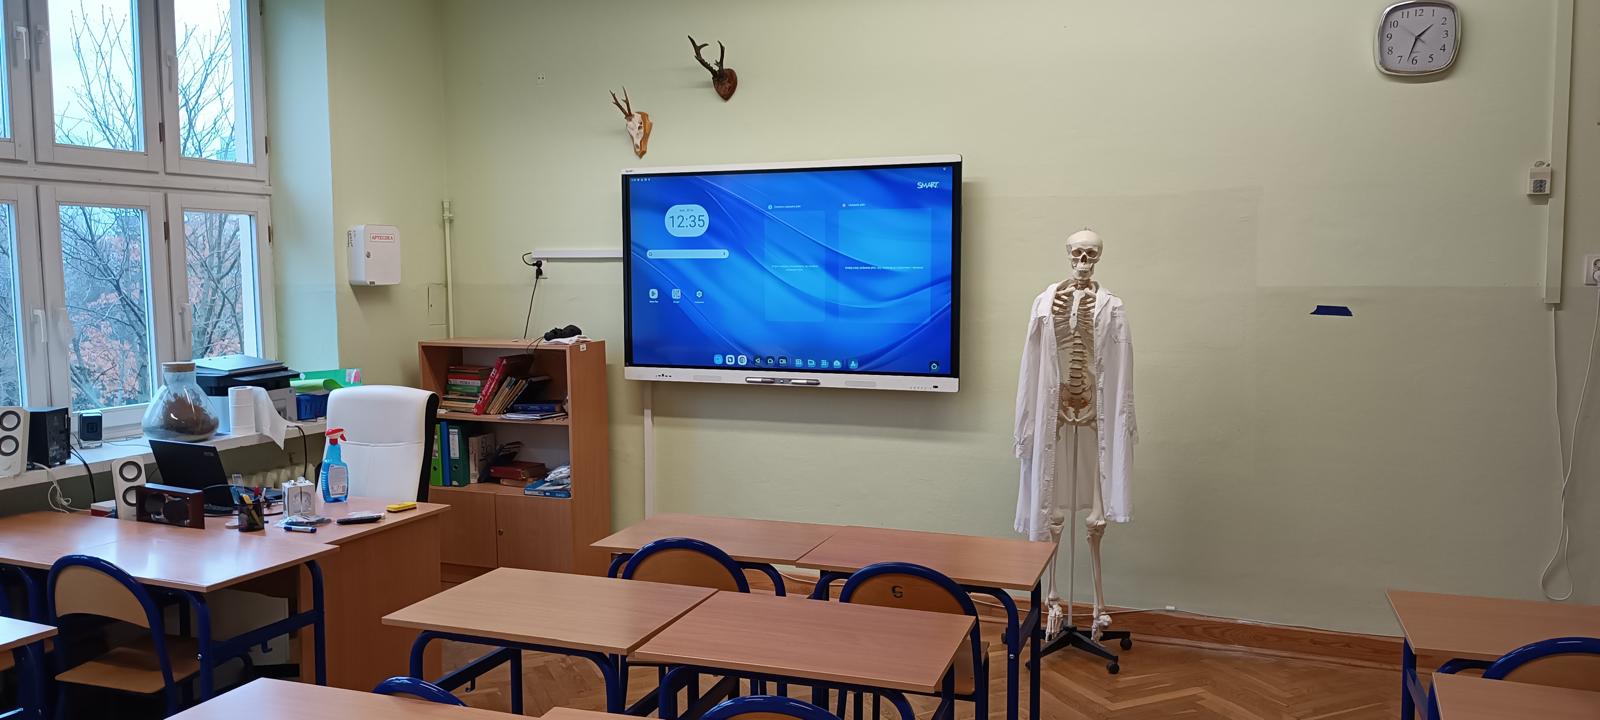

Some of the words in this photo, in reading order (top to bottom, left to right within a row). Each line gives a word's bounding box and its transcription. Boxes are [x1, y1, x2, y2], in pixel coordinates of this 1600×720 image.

[1414, 9, 1424, 17] 12
[1389, 20, 1398, 28] 10
[1441, 17, 1447, 25] 2
[1386, 33, 1393, 41] 9
[1442, 30, 1449, 38] 3
[1387, 46, 1393, 55] 8
[1440, 44, 1446, 52] 4
[1397, 56, 1403, 64] 7
[1411, 56, 1418, 65] 6
[1428, 54, 1434, 63] 5
[916, 181, 940, 189] SMART
[669, 214, 706, 228] 12:35
